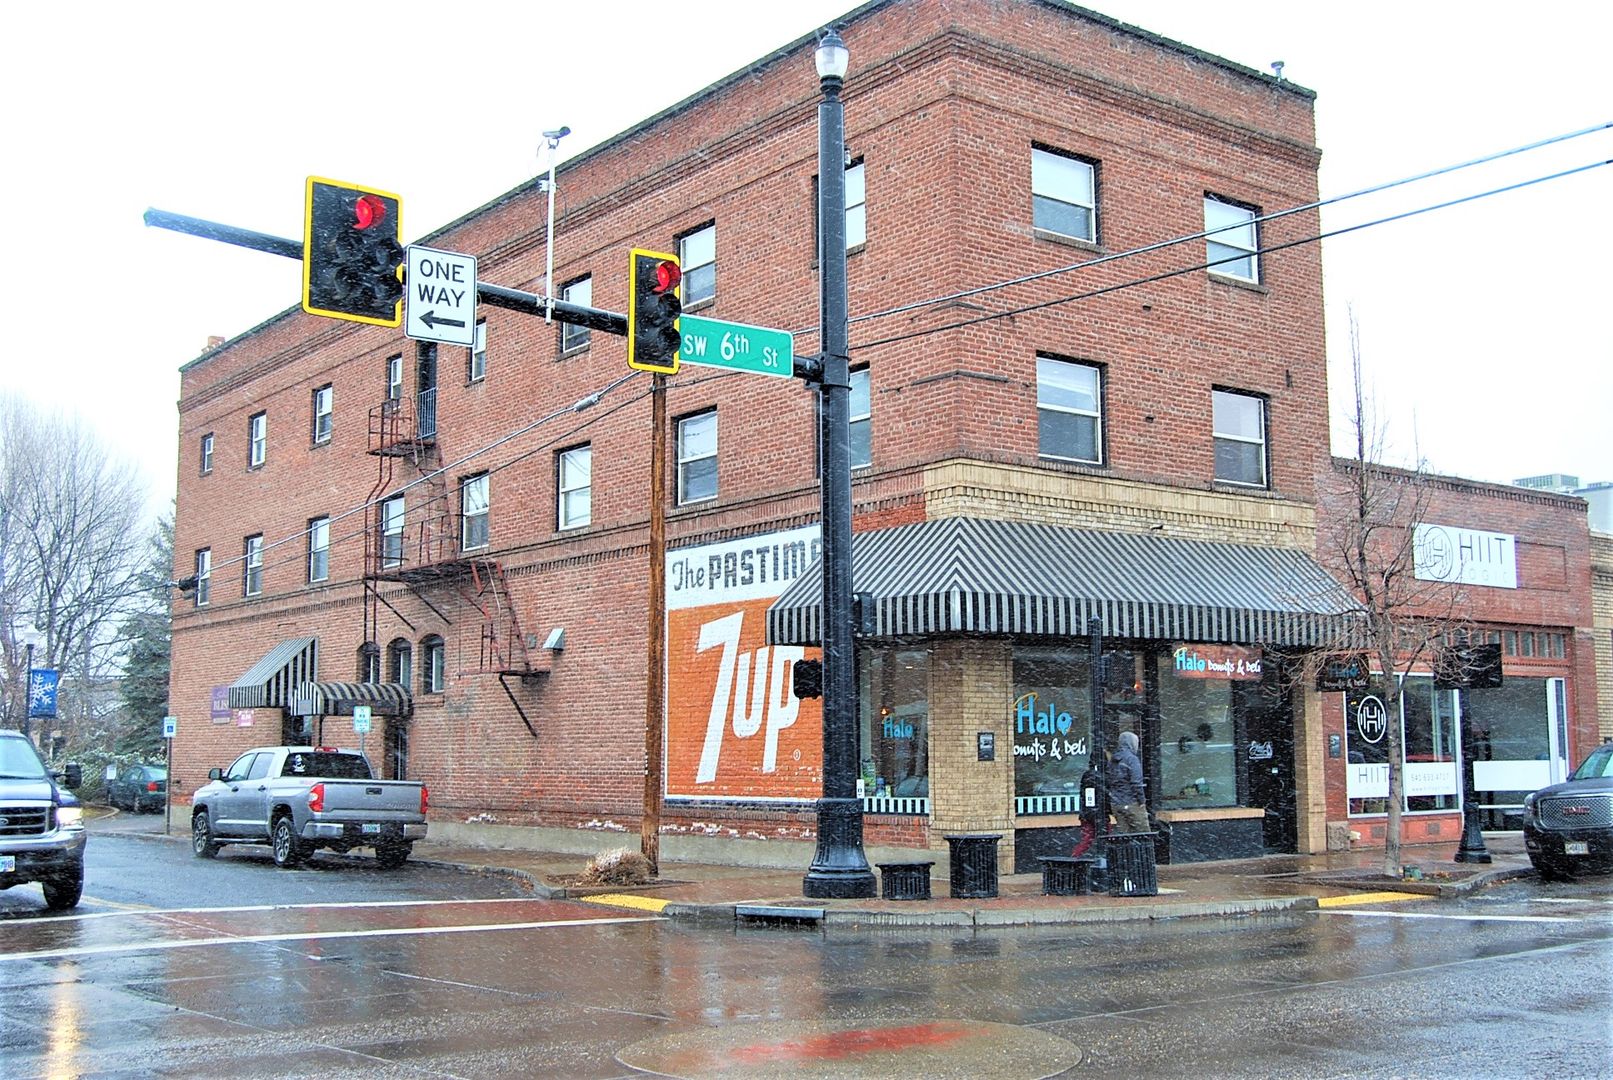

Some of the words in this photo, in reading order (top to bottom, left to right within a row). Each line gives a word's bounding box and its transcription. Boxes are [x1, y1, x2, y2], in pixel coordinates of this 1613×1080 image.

[419, 259, 464, 283] ONE
[418, 283, 466, 308] WAY
[683, 333, 707, 357] SW
[720, 331, 749, 361] 6th
[762, 346, 778, 368] St
[1458, 532, 1506, 564] HIIT
[672, 558, 704, 592] The
[1174, 647, 1206, 671] Halo
[1237, 659, 1246, 675] &
[882, 714, 914, 738] Halo
[1014, 692, 1073, 736] Halo
[1013, 737, 1047, 762] onuts
[1050, 737, 1062, 761] &
[1064, 737, 1087, 756] Deli
